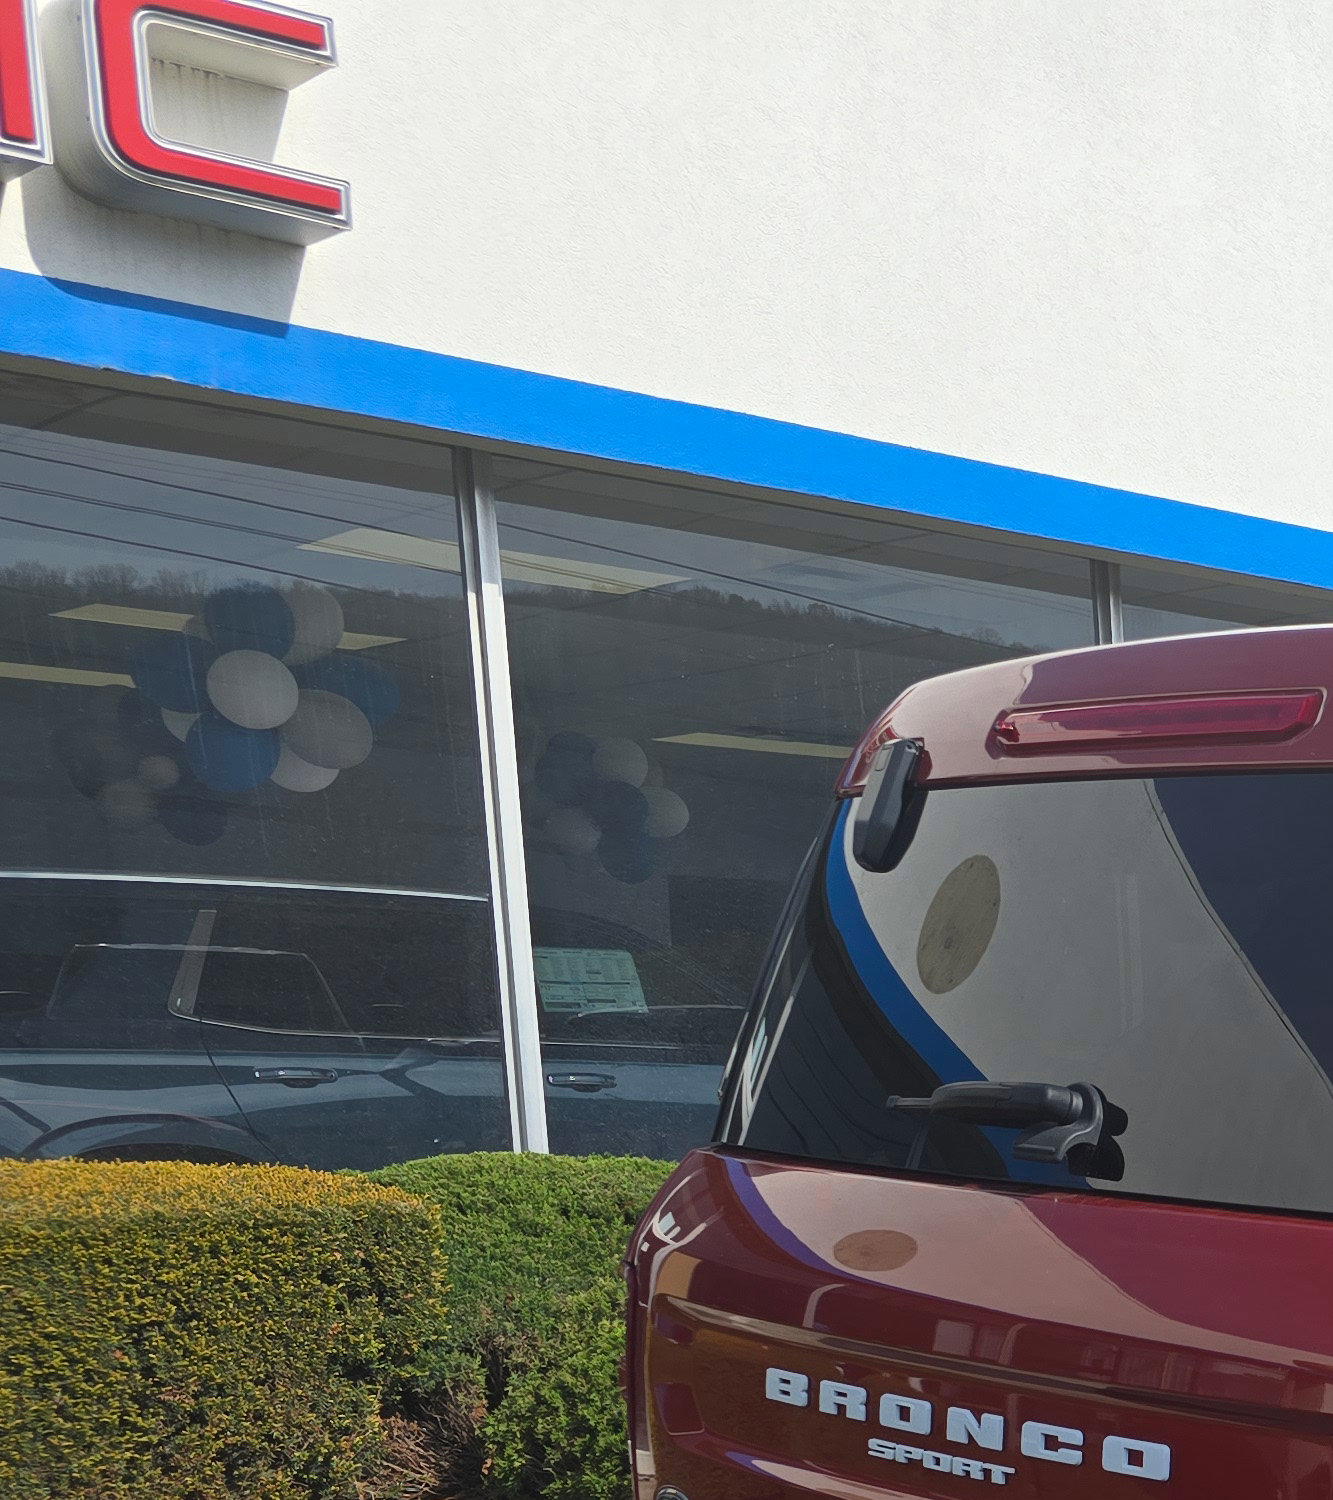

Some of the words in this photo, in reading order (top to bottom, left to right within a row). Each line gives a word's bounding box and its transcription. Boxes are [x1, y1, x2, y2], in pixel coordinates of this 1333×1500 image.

[0, 0, 352, 231] C
[765, 1367, 1171, 1481] BRONCO
[868, 1438, 1015, 1485] SPORT
